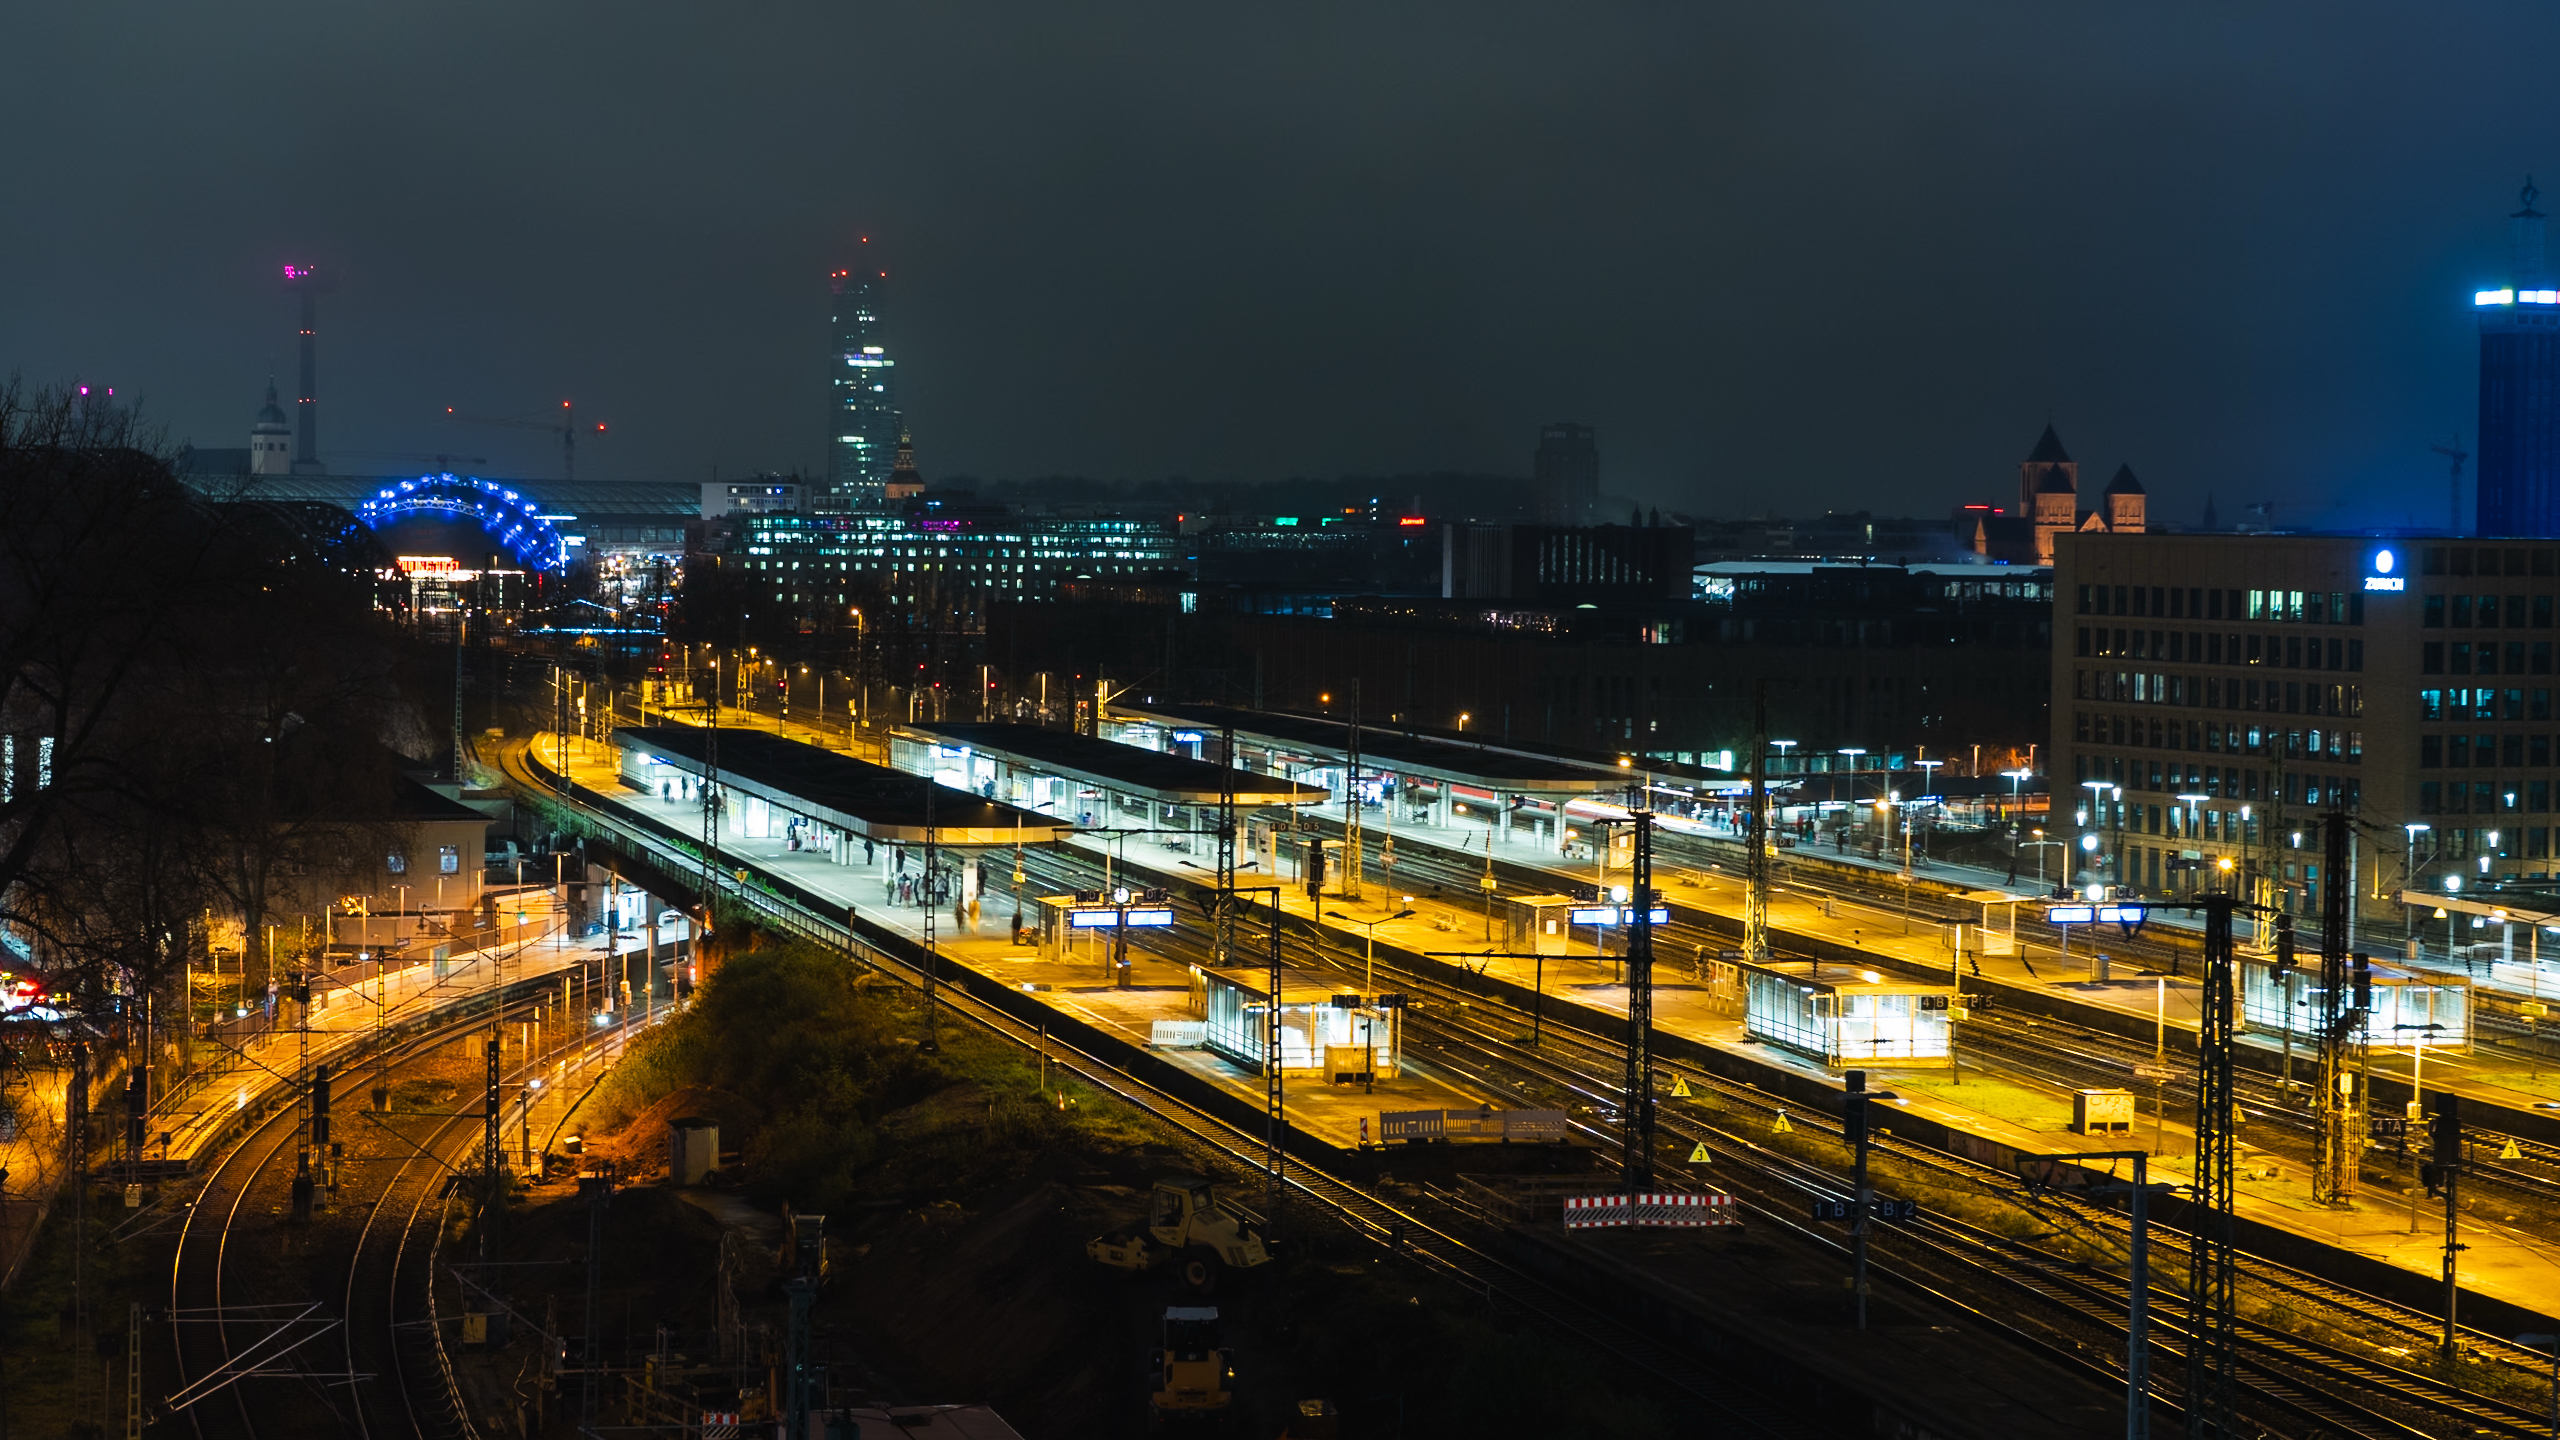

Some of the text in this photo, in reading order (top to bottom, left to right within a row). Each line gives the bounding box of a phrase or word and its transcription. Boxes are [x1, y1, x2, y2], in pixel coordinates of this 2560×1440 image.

[2128, 887, 2135, 896] 8
[246, 999, 254, 1009] G
[1347, 994, 1357, 1006] C
[1383, 994, 1407, 1005] C 2
[1922, 997, 1930, 1008] 4
[1678, 1085, 1684, 1095] 3
[2375, 1121, 2402, 1133] 4 A
[1697, 1149, 1703, 1161] 3
[2508, 1146, 2514, 1157] 3
[1815, 1202, 1845, 1217] 1 B
[1883, 1201, 1914, 1216] B 2
